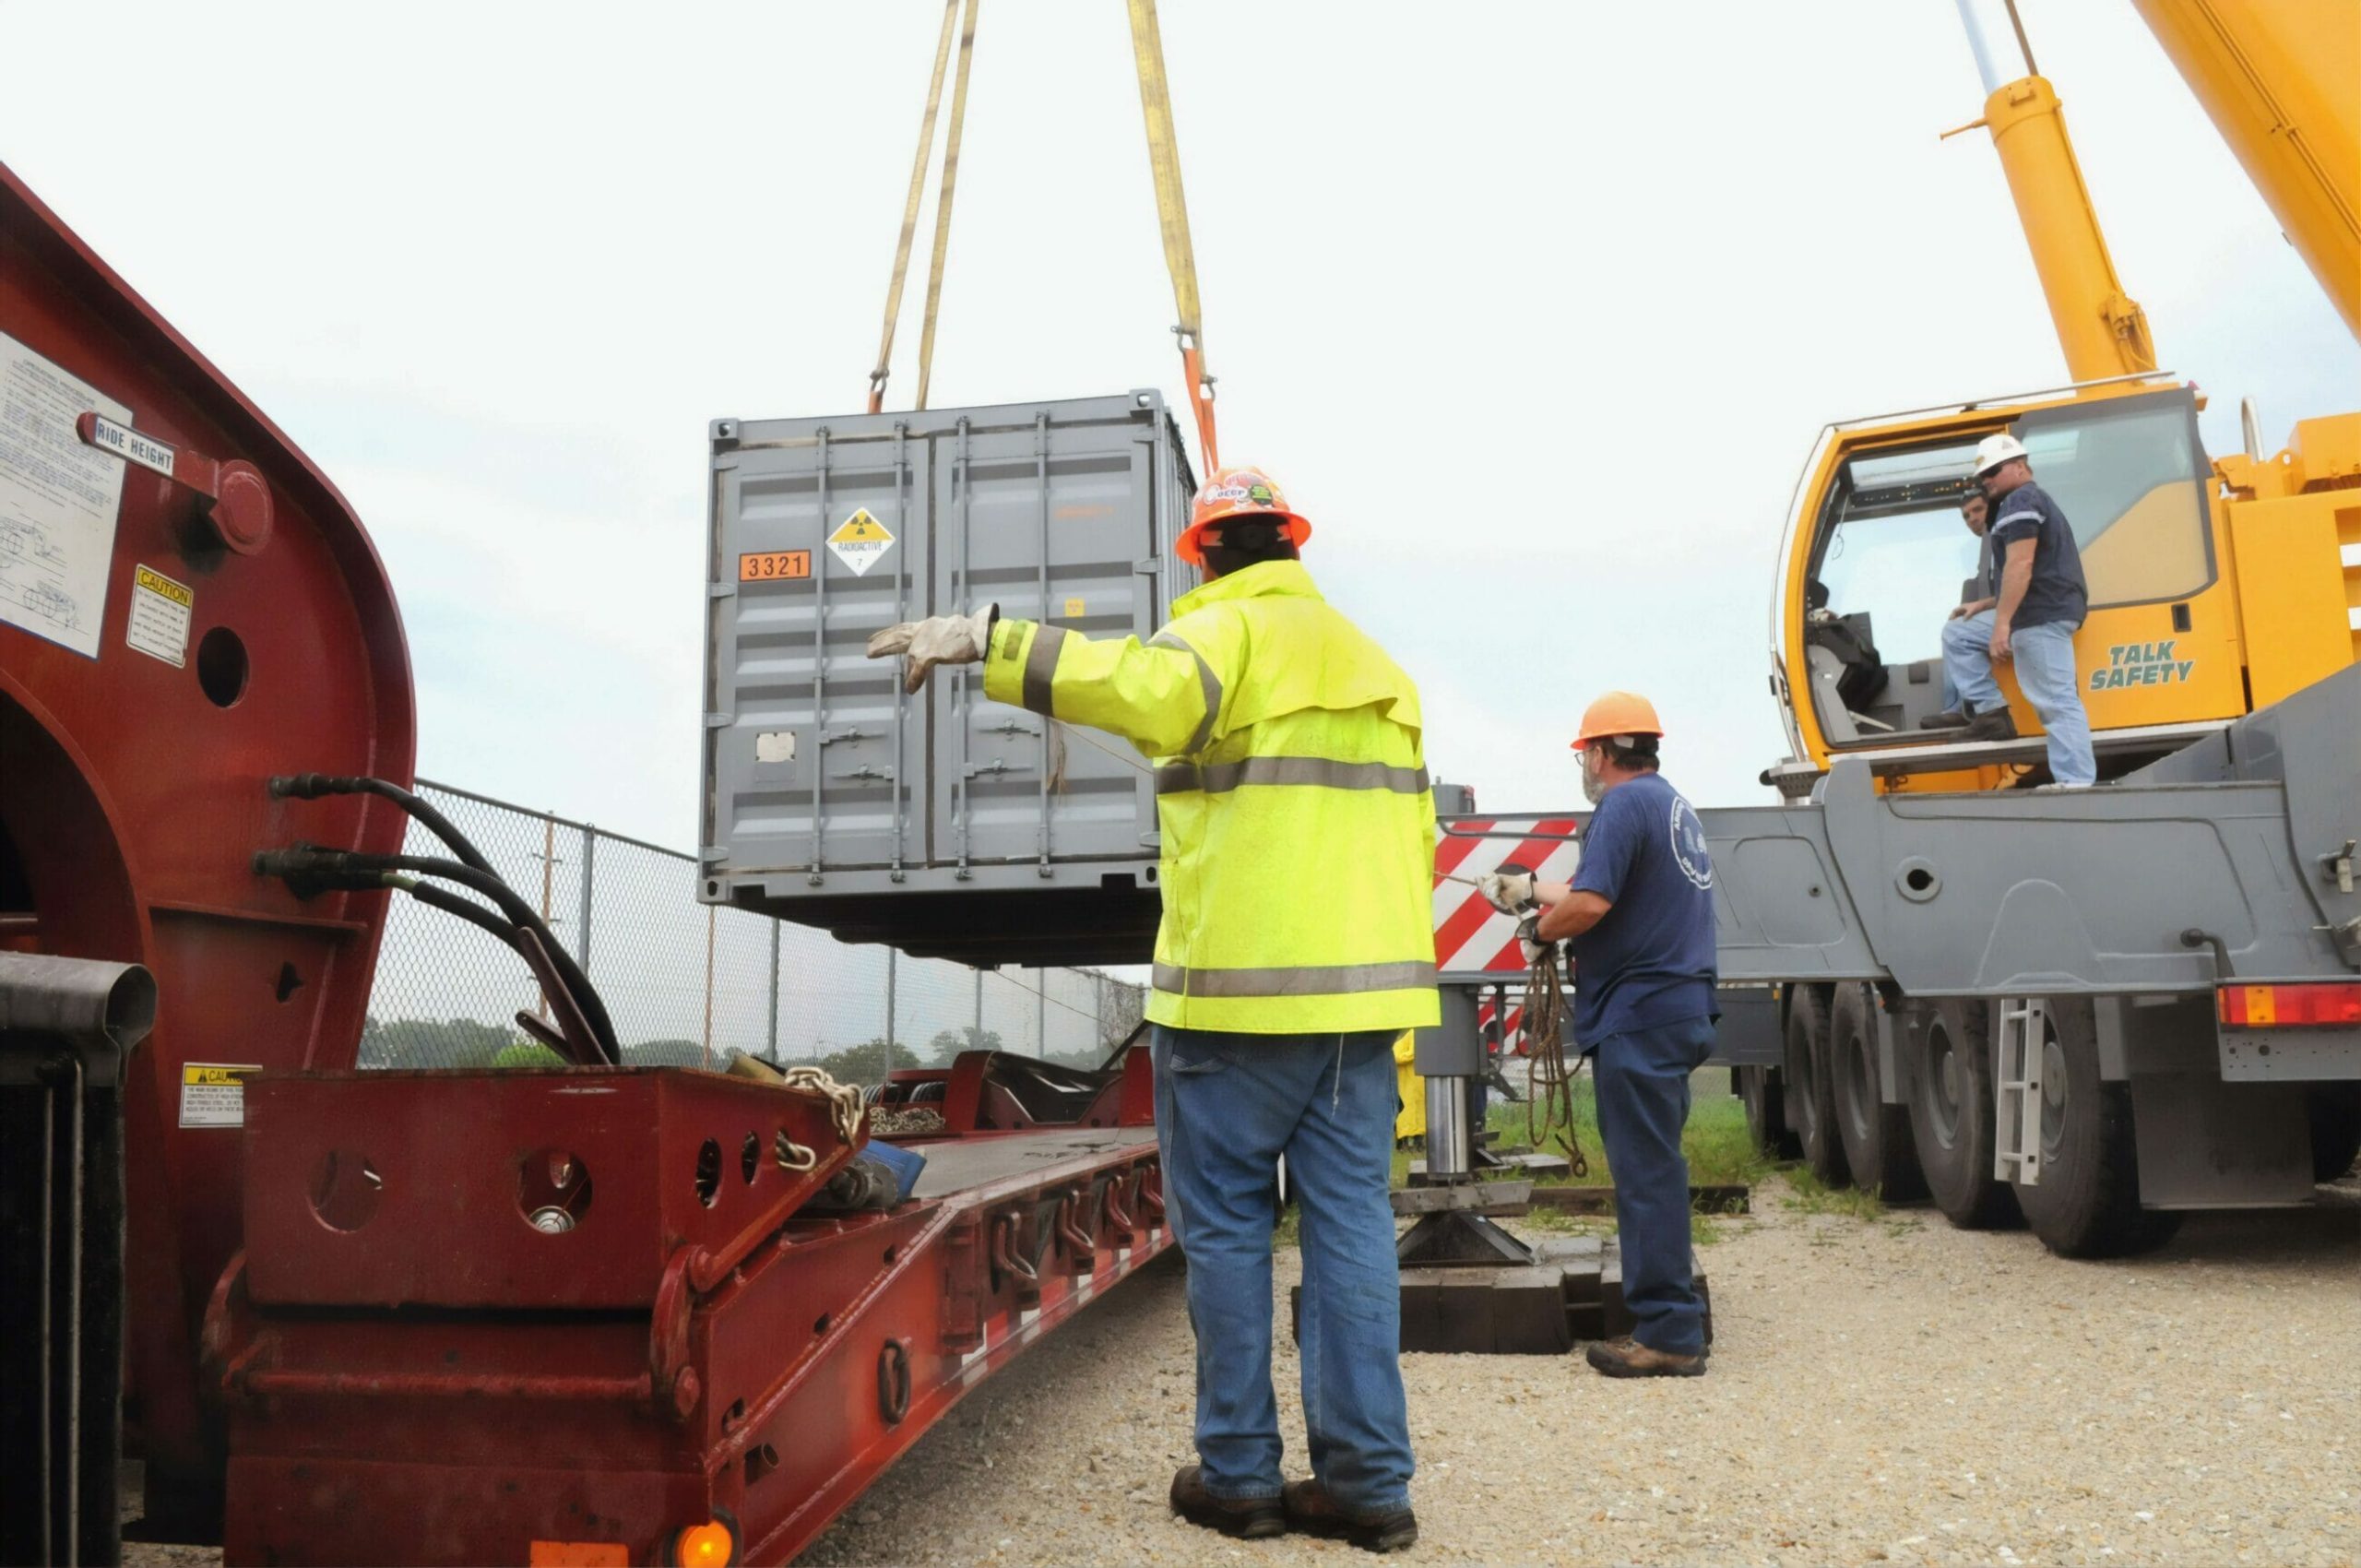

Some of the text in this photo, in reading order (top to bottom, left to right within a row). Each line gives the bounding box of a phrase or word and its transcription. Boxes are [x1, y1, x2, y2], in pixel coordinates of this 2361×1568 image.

[97, 422, 172, 469] RIDE HEIGHT
[837, 540, 882, 552] RADIOACTIVE
[748, 554, 801, 577] 3321
[856, 558, 863, 566] 7
[140, 572, 189, 604] CAUTION
[2109, 640, 2176, 666] TALK
[2089, 660, 2194, 691] SAFETY
